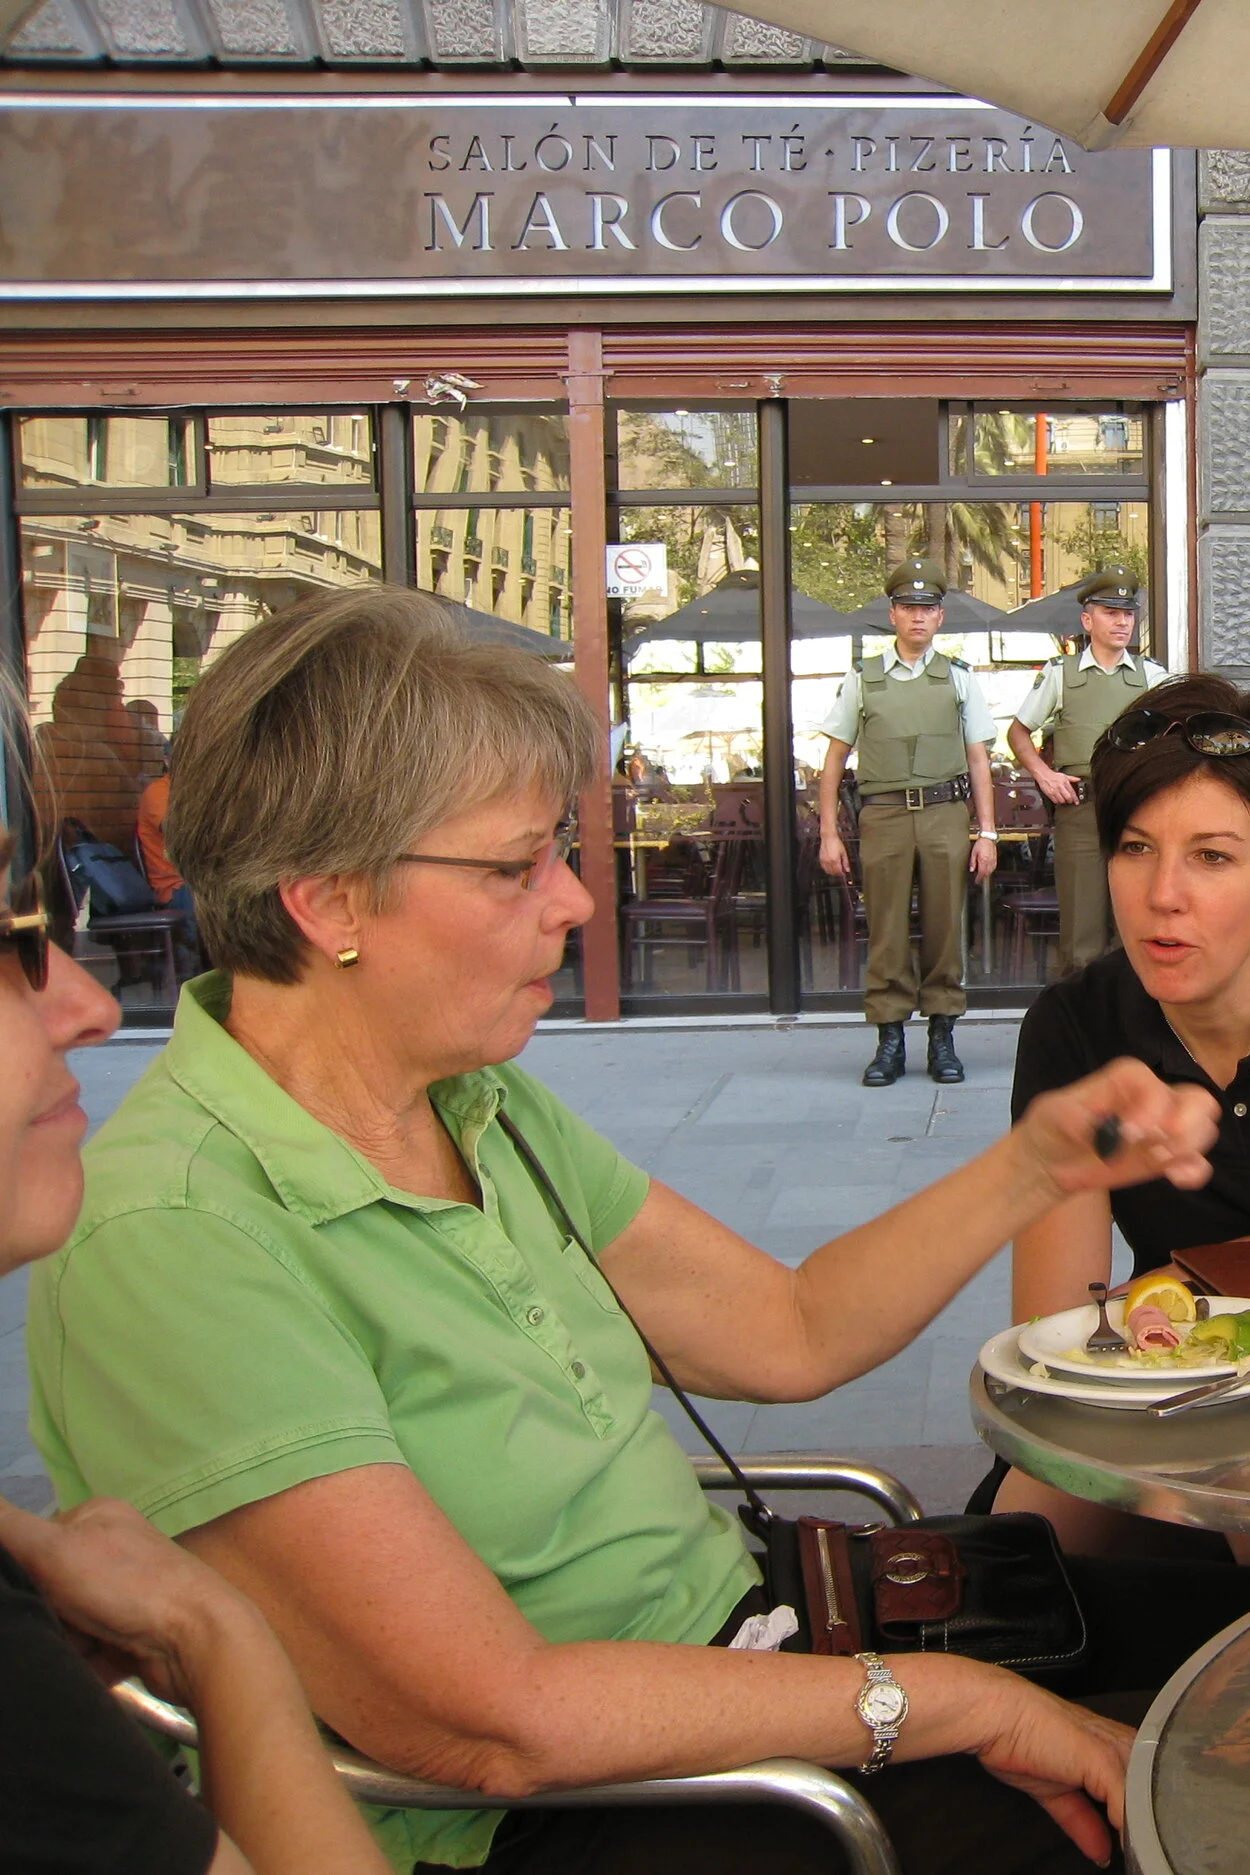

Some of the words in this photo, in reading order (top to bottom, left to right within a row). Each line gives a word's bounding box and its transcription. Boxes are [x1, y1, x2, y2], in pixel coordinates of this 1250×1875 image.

[428, 123, 617, 173] SALÓN
[644, 134, 719, 173] DE
[741, 124, 808, 173] TÉ
[850, 125, 1077, 173] PIZERÍA
[424, 191, 784, 253] MARCO
[827, 191, 1085, 253] POLO
